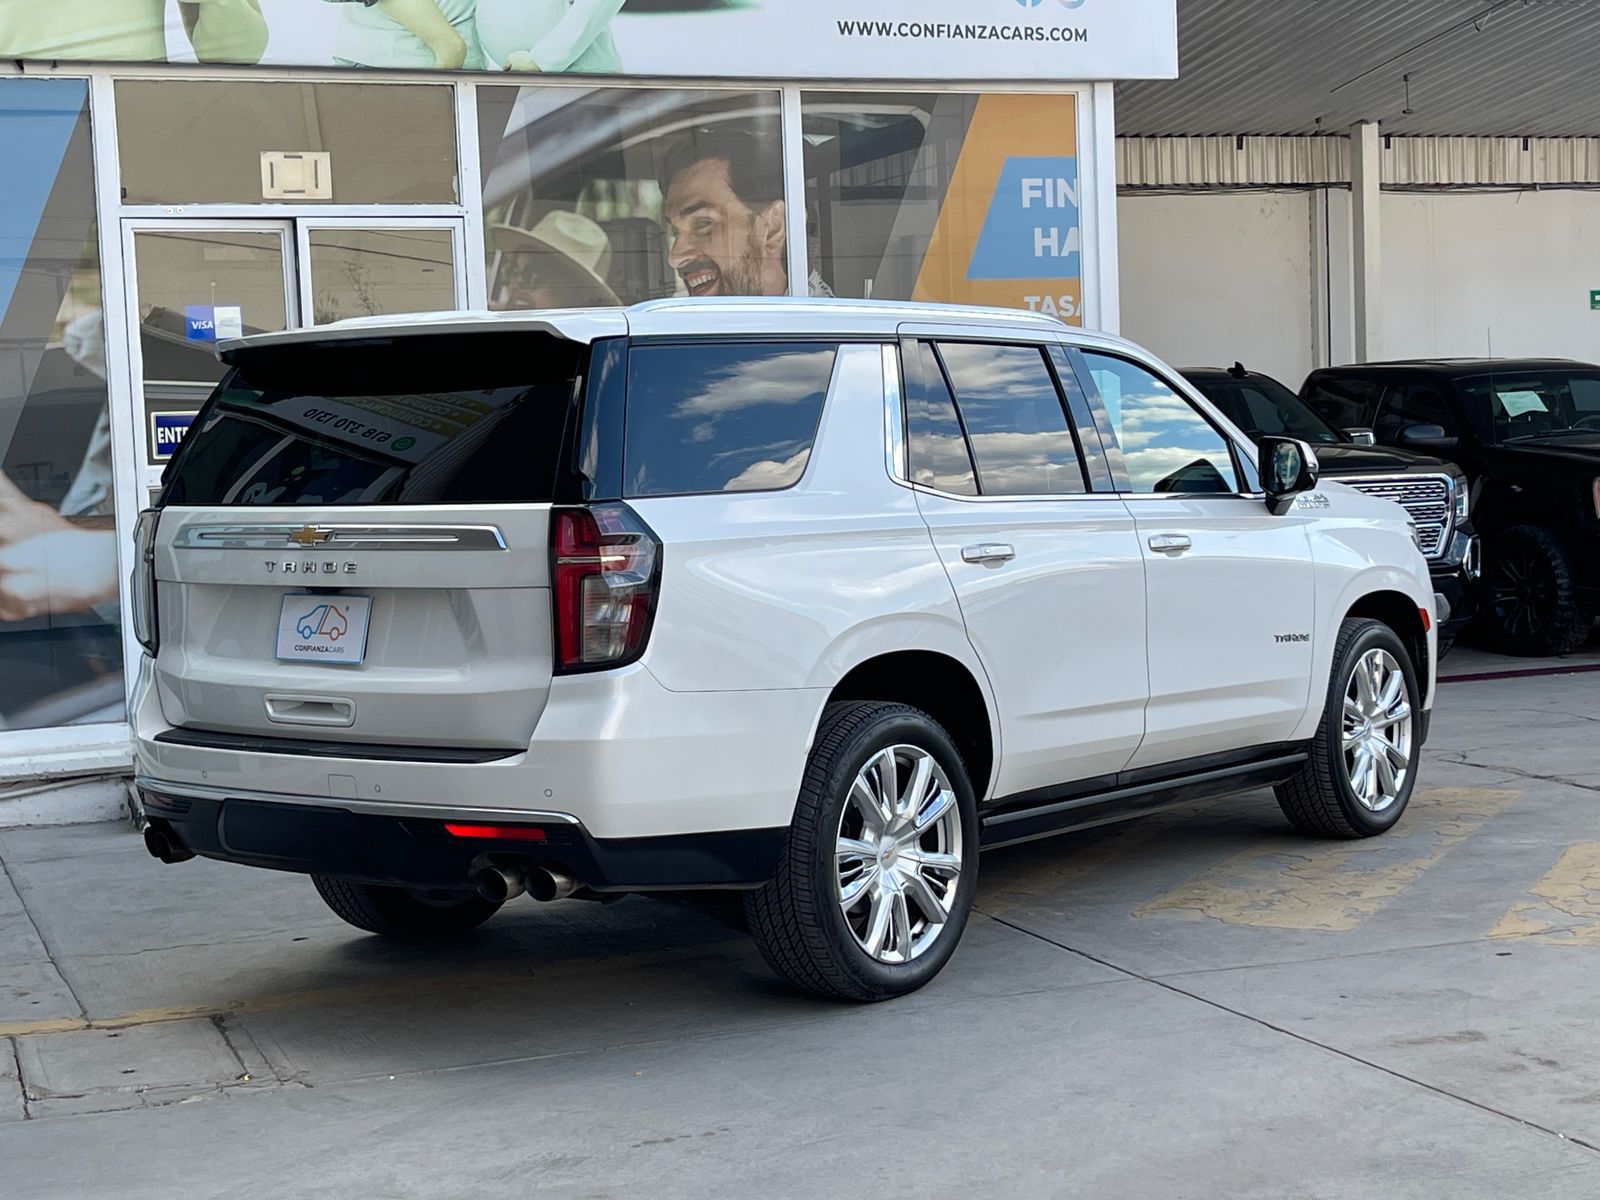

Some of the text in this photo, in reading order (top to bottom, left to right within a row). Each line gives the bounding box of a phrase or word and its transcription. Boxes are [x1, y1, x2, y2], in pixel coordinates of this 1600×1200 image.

[837, 20, 1088, 42] WWW.CONFIANZACARS.COM
[1023, 295, 1081, 317] TAS
[191, 320, 214, 330] VISA
[265, 561, 357, 574] TAHOE
